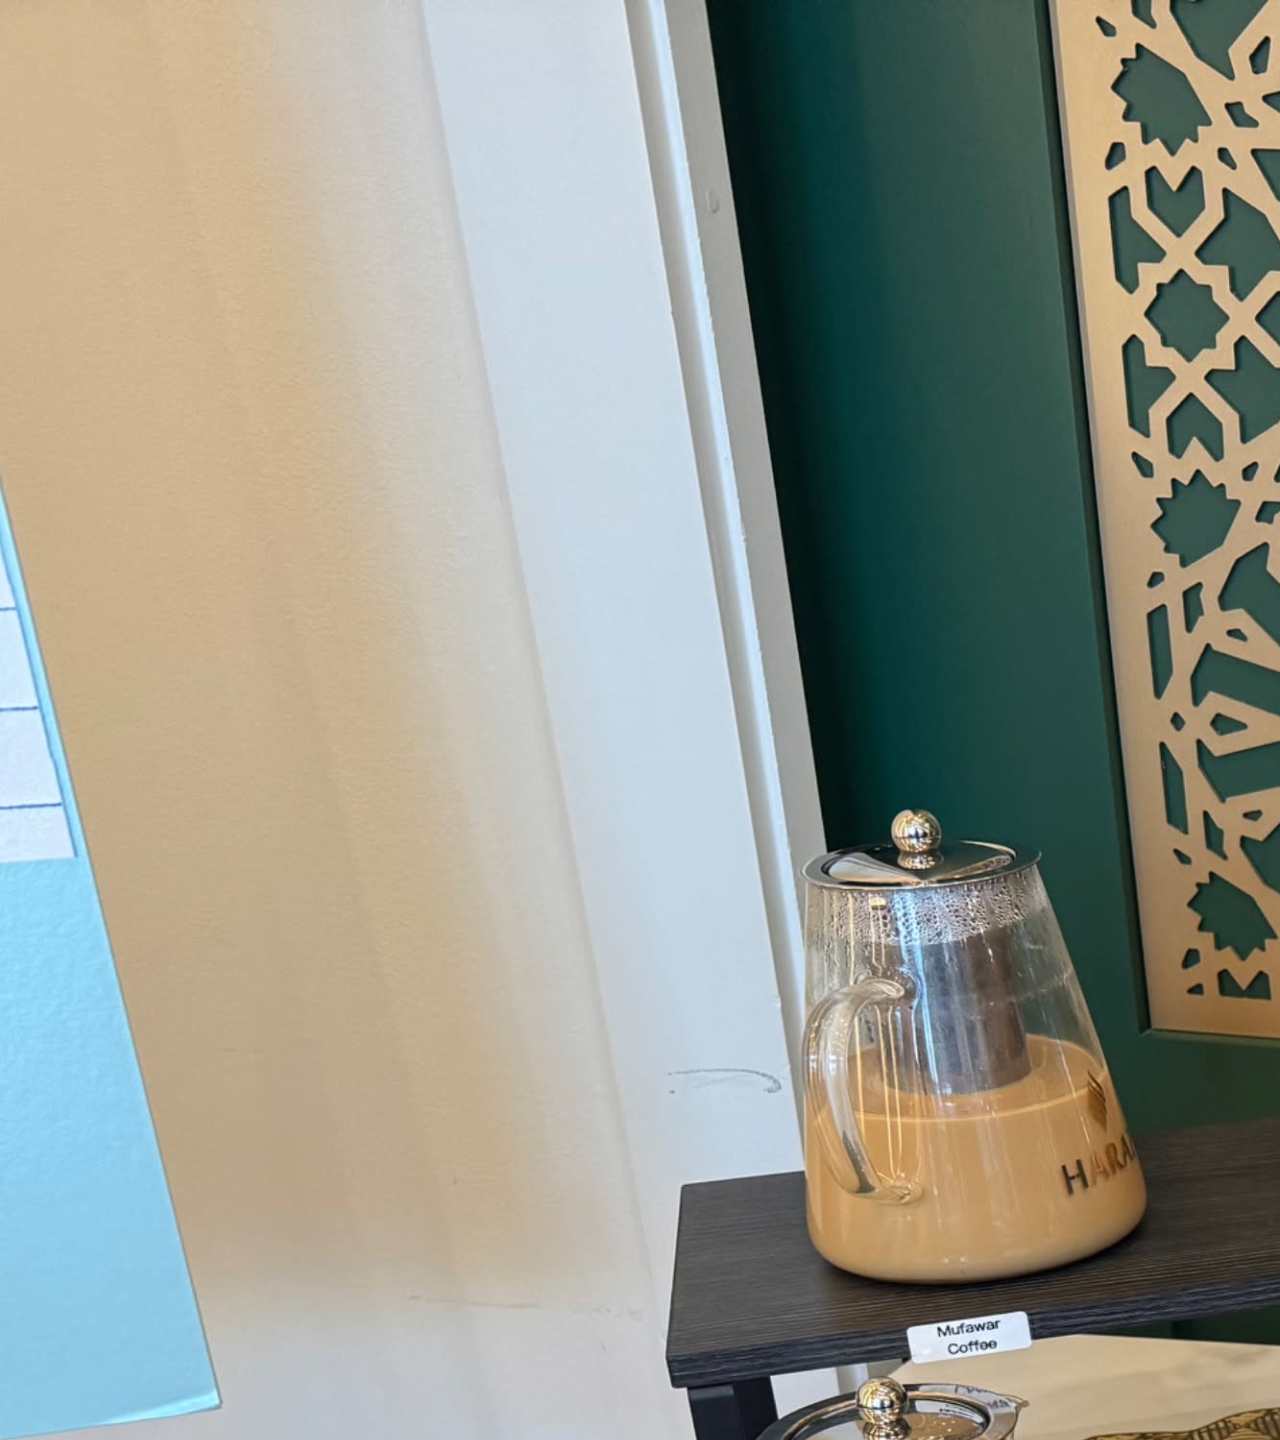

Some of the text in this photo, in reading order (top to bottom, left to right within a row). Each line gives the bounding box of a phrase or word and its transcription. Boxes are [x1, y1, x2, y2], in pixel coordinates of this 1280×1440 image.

[1061, 1132, 1138, 1196] HARA
[936, 1320, 1001, 1338] Mufawar
[947, 1339, 998, 1355] Coffee
